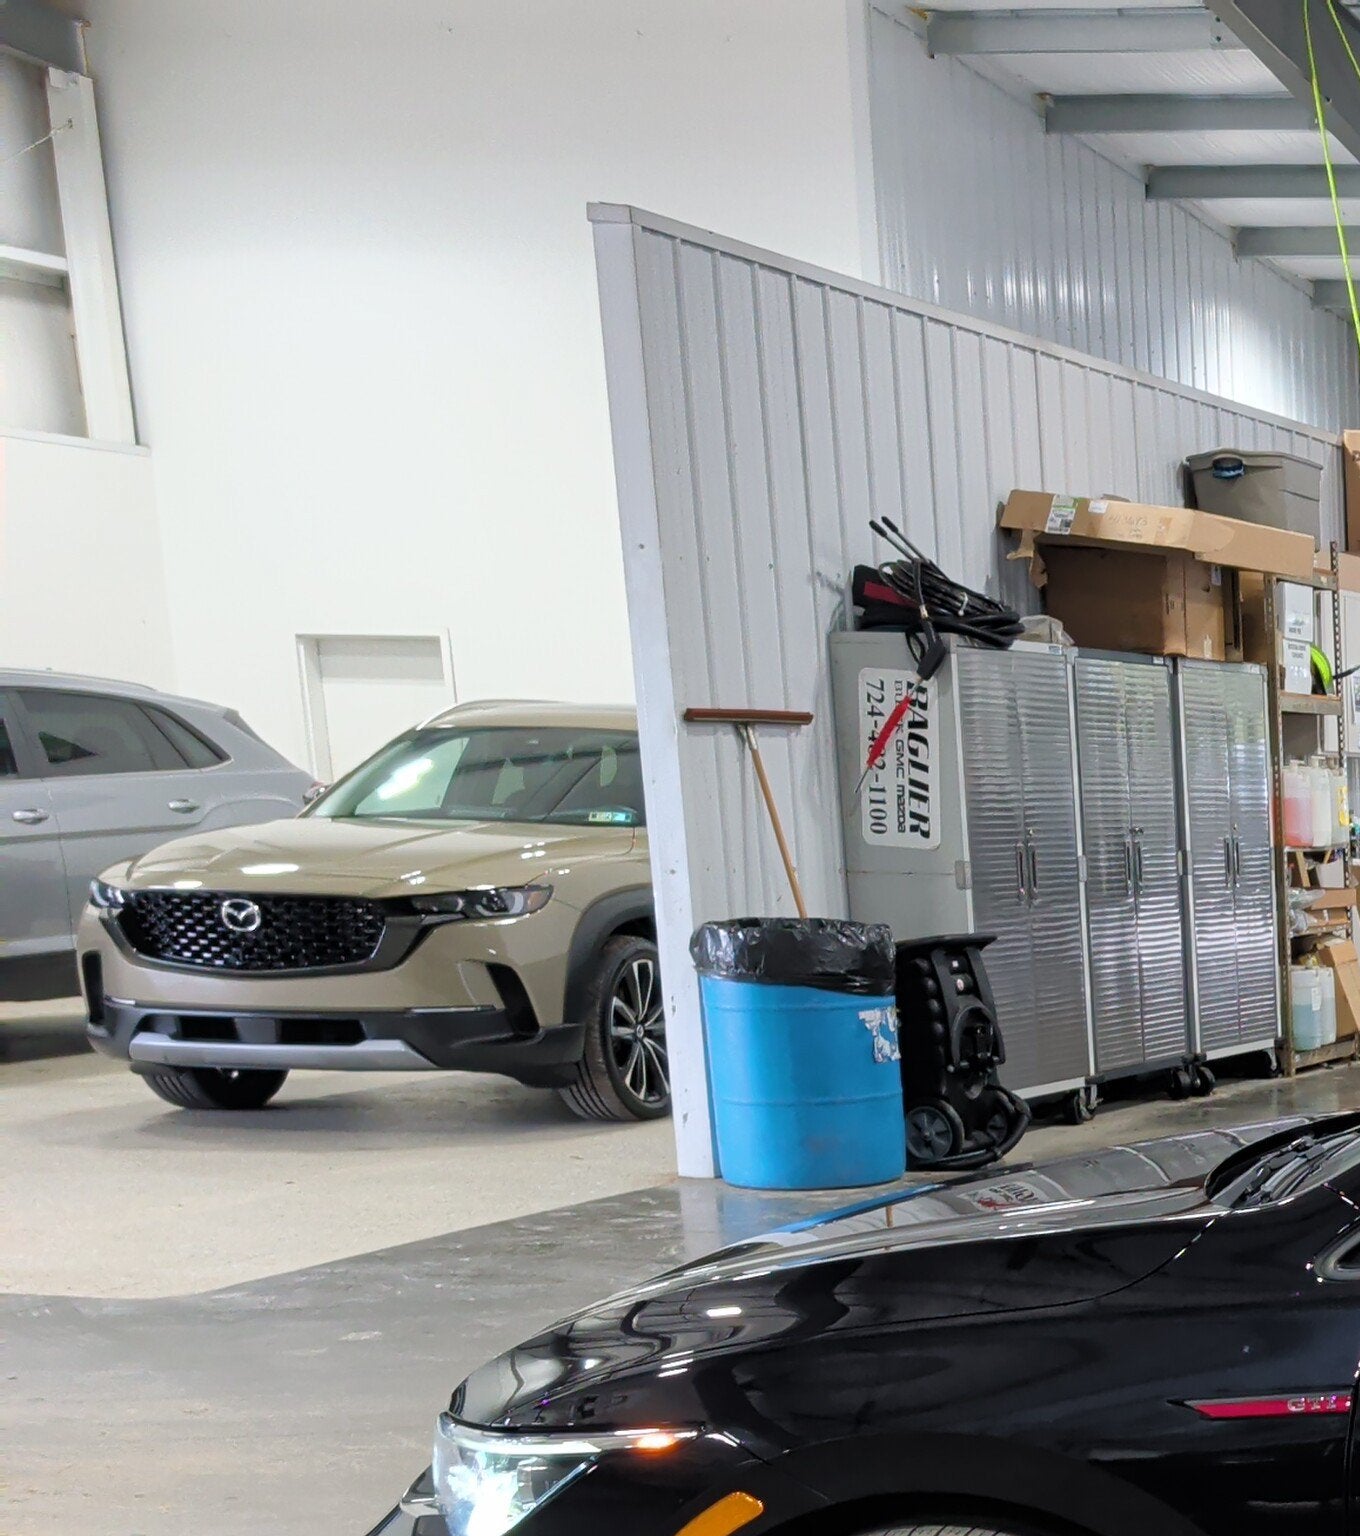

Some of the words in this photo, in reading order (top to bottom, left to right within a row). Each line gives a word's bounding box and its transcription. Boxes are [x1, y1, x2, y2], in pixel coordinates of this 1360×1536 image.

[895, 739, 905, 778] GMC
[906, 680, 931, 839] BAGLIER
[896, 785, 906, 833] mazda
[1287, 1397, 1337, 1412] GTI
